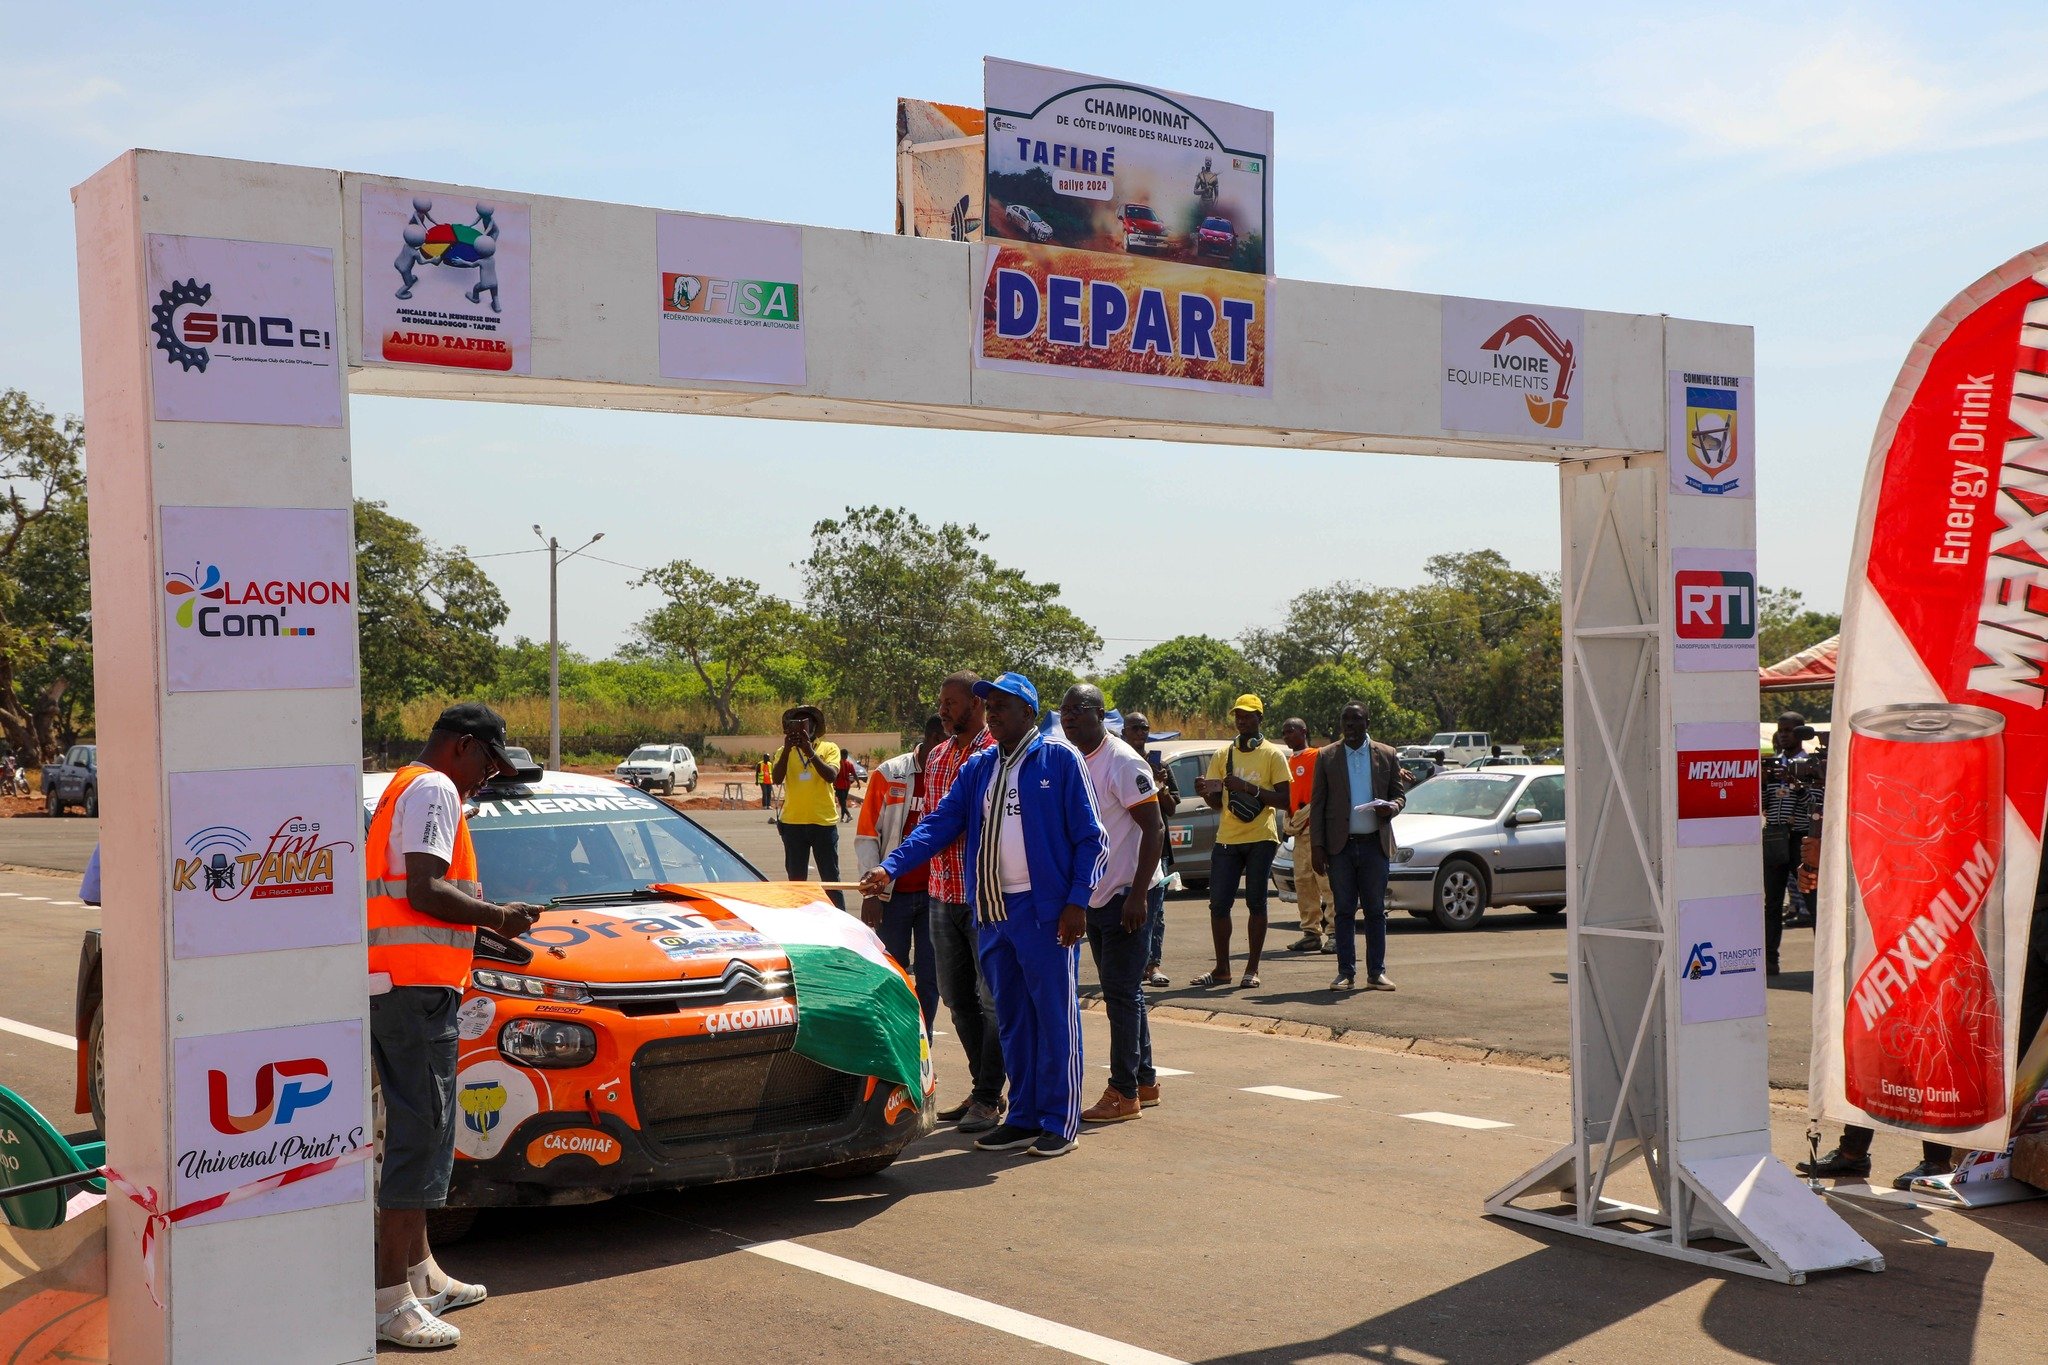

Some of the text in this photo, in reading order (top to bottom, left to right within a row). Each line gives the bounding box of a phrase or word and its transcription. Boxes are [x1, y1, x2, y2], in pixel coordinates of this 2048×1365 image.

[1085, 98, 1189, 130] CHAMPIONNAT
[1057, 115, 1214, 151] DE CÔTE D'IVOIRE DES RALLYES 2024
[1017, 137, 1115, 177] TAFIRÉ
[1087, 181, 1107, 191] 2024
[704, 279, 789, 318] FISA
[396, 308, 427, 317] AMICALE
[700, 316, 733, 325] IVOIRIENNE
[743, 319, 762, 327] SPORT
[763, 321, 800, 330] AUTOMOBILE
[996, 268, 1254, 365] DEPART
[183, 312, 294, 348] SMC
[473, 323, 496, 331] TAFIRE
[390, 331, 507, 353] AJUD TAFIRE
[1493, 353, 1549, 374] IVOIRE
[1447, 368, 1549, 391] EQUIPEMENTS
[1683, 373, 1739, 387] COMMUNE DE TAFIRE
[1948, 373, 1995, 453] Drink
[1933, 459, 1989, 566] Energy
[224, 581, 350, 605] LAGNON
[1681, 585, 1750, 625] RTI
[199, 606, 286, 637] Com'
[1688, 760, 1759, 780] MAXIMUM
[501, 797, 658, 816] HERMES
[290, 823, 320, 833] 89.9
[1854, 841, 1995, 1032] MAXIMUM
[1718, 948, 1762, 960] TRANSPORT
[705, 1006, 798, 1033] CACOMIA
[208, 1057, 333, 1135] UP
[1881, 1079, 1960, 1103] Energy Drink
[177, 1141, 278, 1180] Universal
